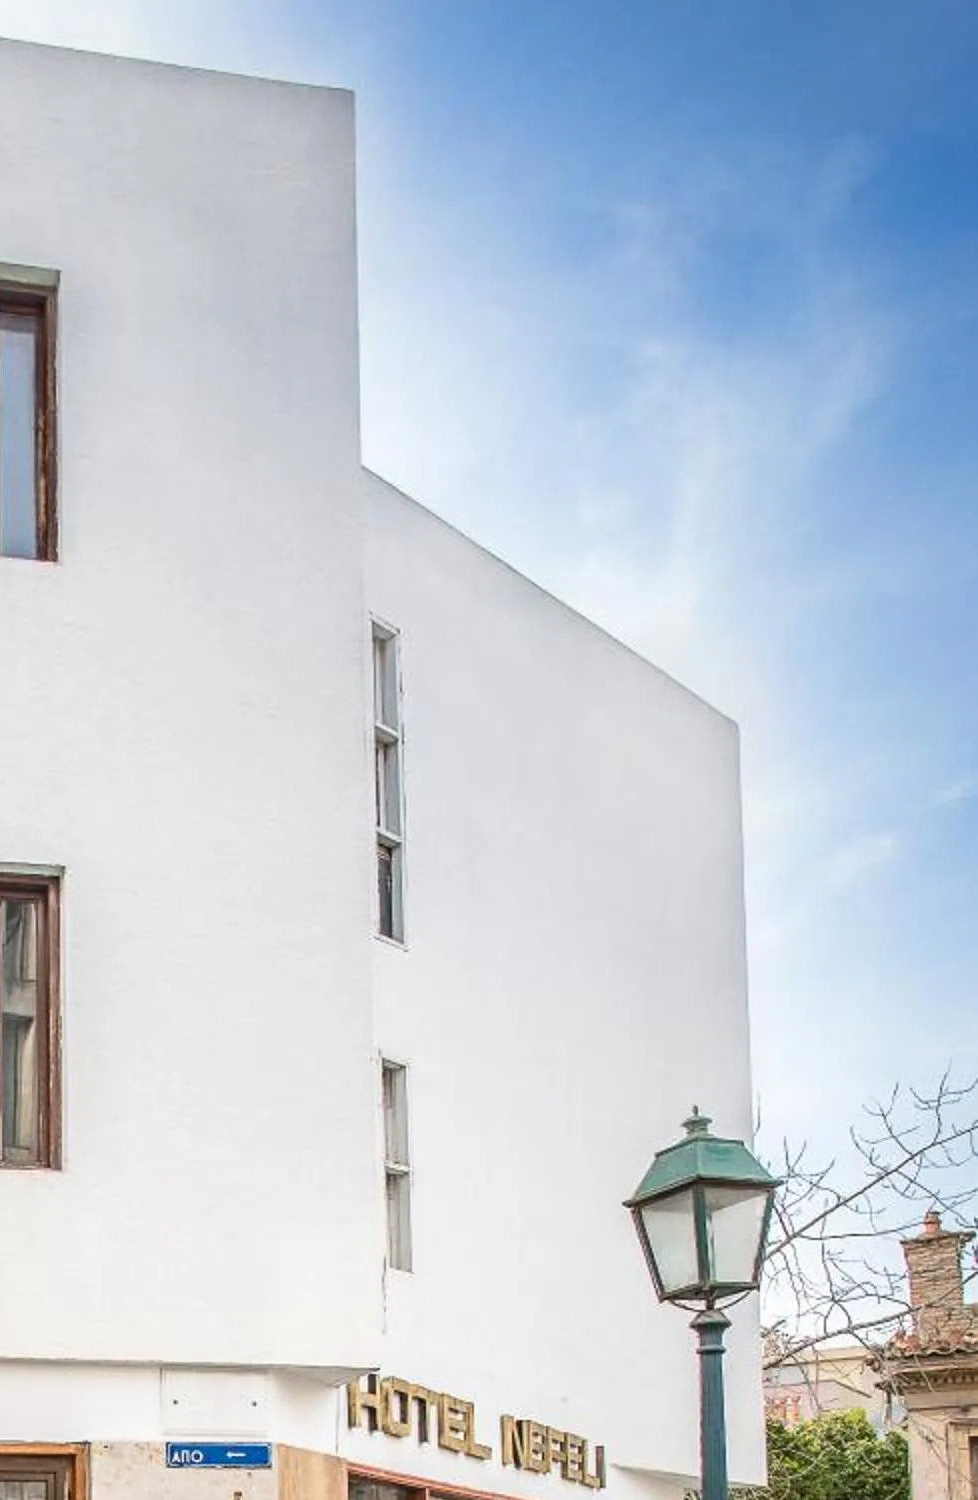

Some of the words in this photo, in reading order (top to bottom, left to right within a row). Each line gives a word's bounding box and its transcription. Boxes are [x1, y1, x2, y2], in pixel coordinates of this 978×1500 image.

[171, 1449, 203, 1463] ΑΠΟ
[348, 1373, 493, 1461] HOTEL
[500, 1414, 606, 1489] NEFELI
